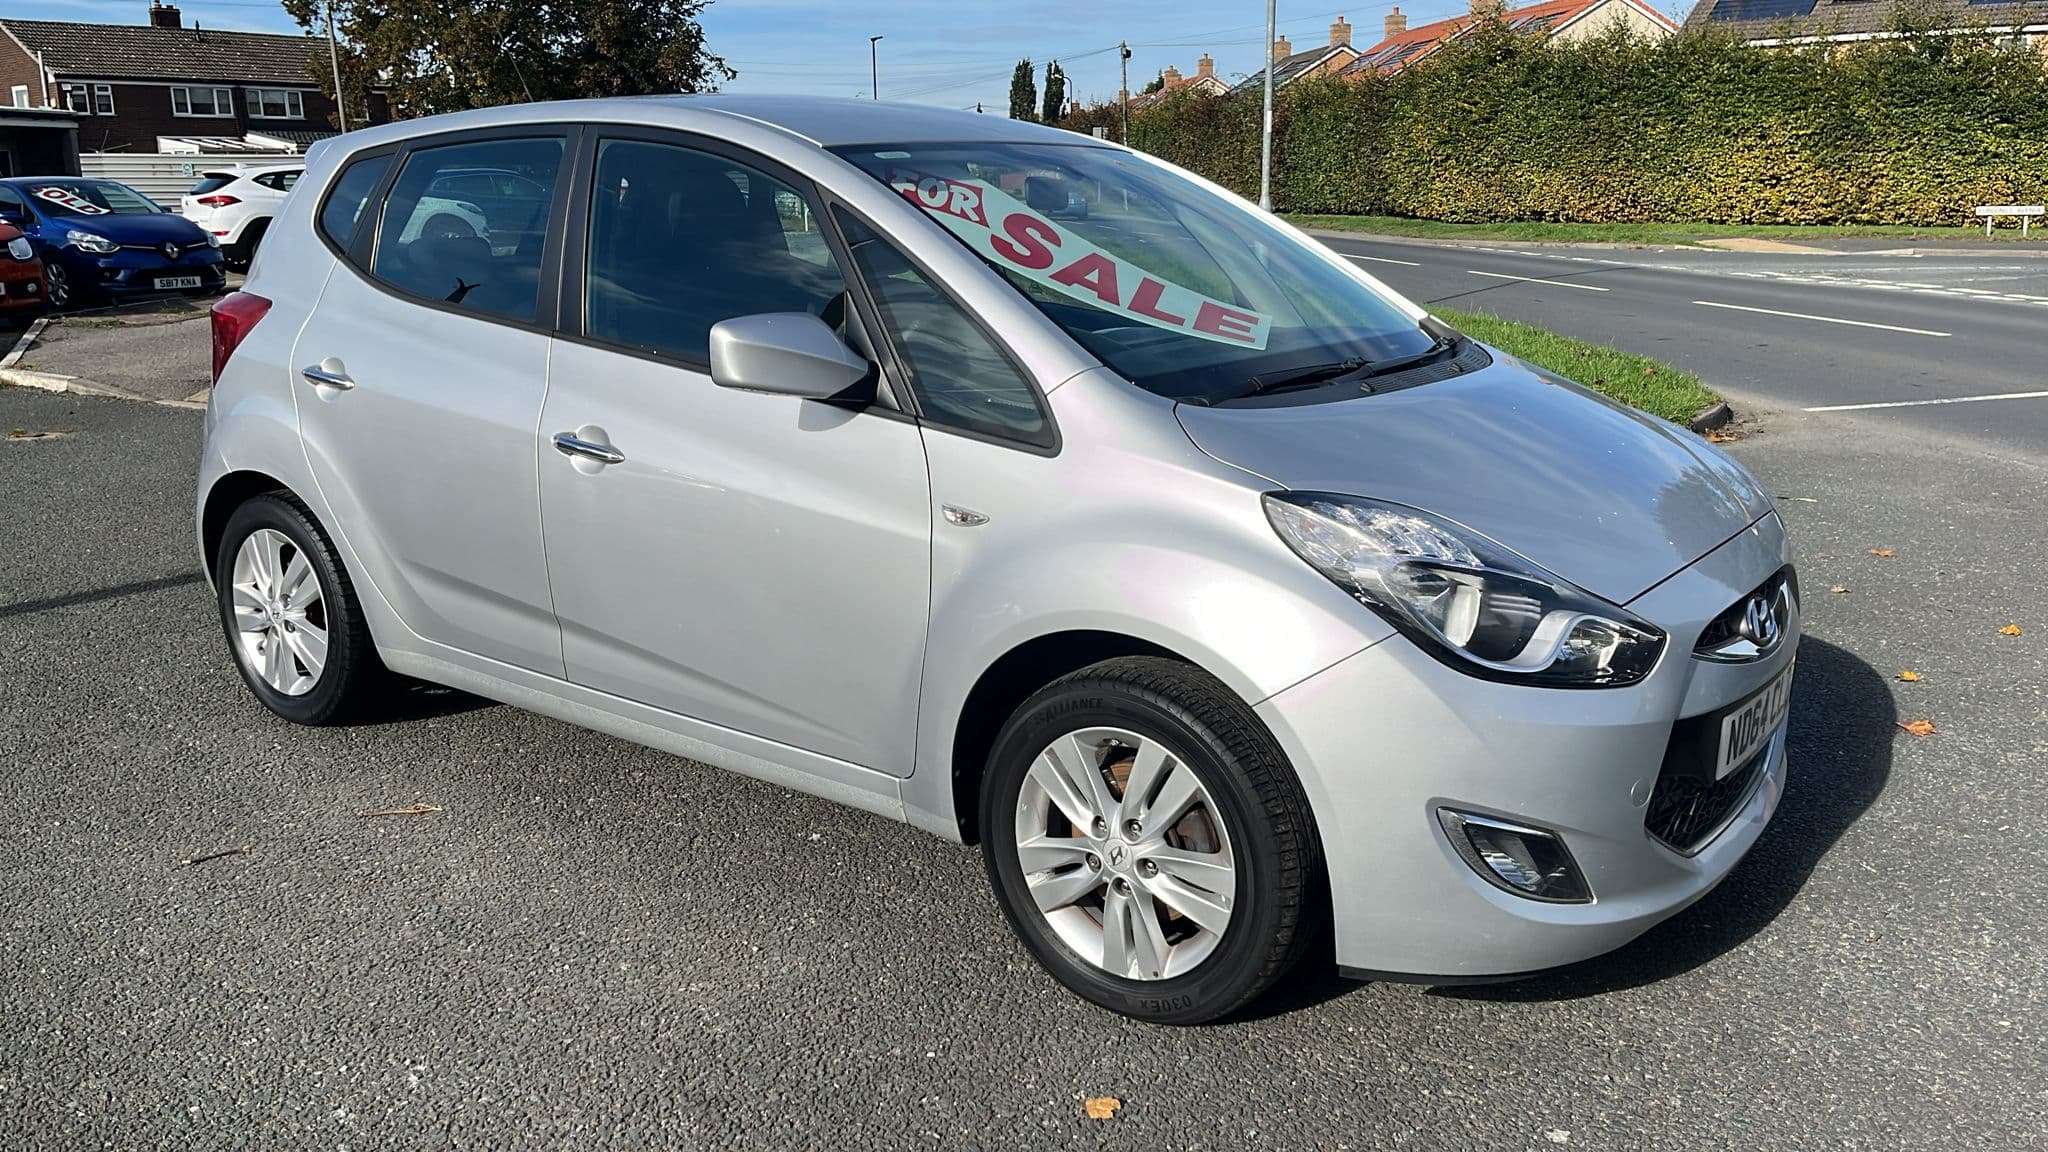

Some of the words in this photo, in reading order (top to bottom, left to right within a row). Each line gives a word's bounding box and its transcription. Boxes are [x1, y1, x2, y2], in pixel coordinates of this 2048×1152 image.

[160, 278, 179, 288] SB17
[990, 213, 1260, 344] SALE
[1726, 690, 1770, 766] ND64
